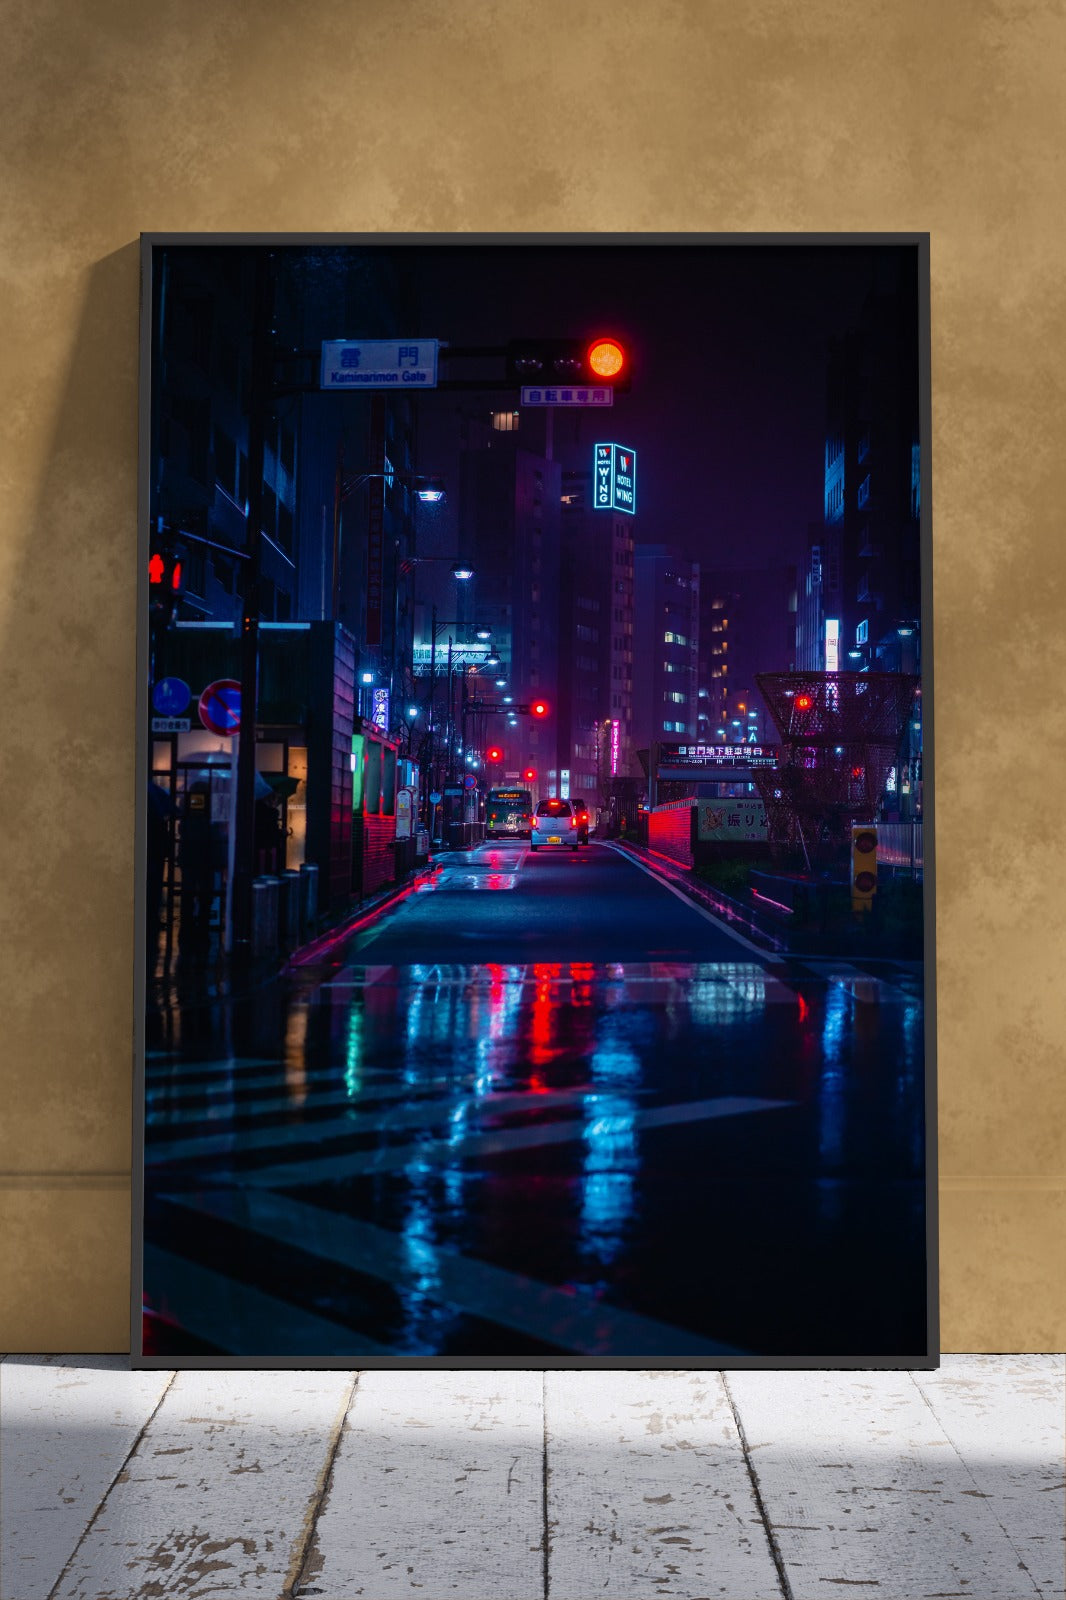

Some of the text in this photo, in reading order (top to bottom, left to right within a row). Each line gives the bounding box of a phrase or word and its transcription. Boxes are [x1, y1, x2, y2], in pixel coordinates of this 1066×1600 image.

[331, 370, 426, 383] Kaminarimon Gate
[598, 467, 610, 503] WING
[616, 474, 632, 488] HOTEL
[616, 487, 633, 503] WING
